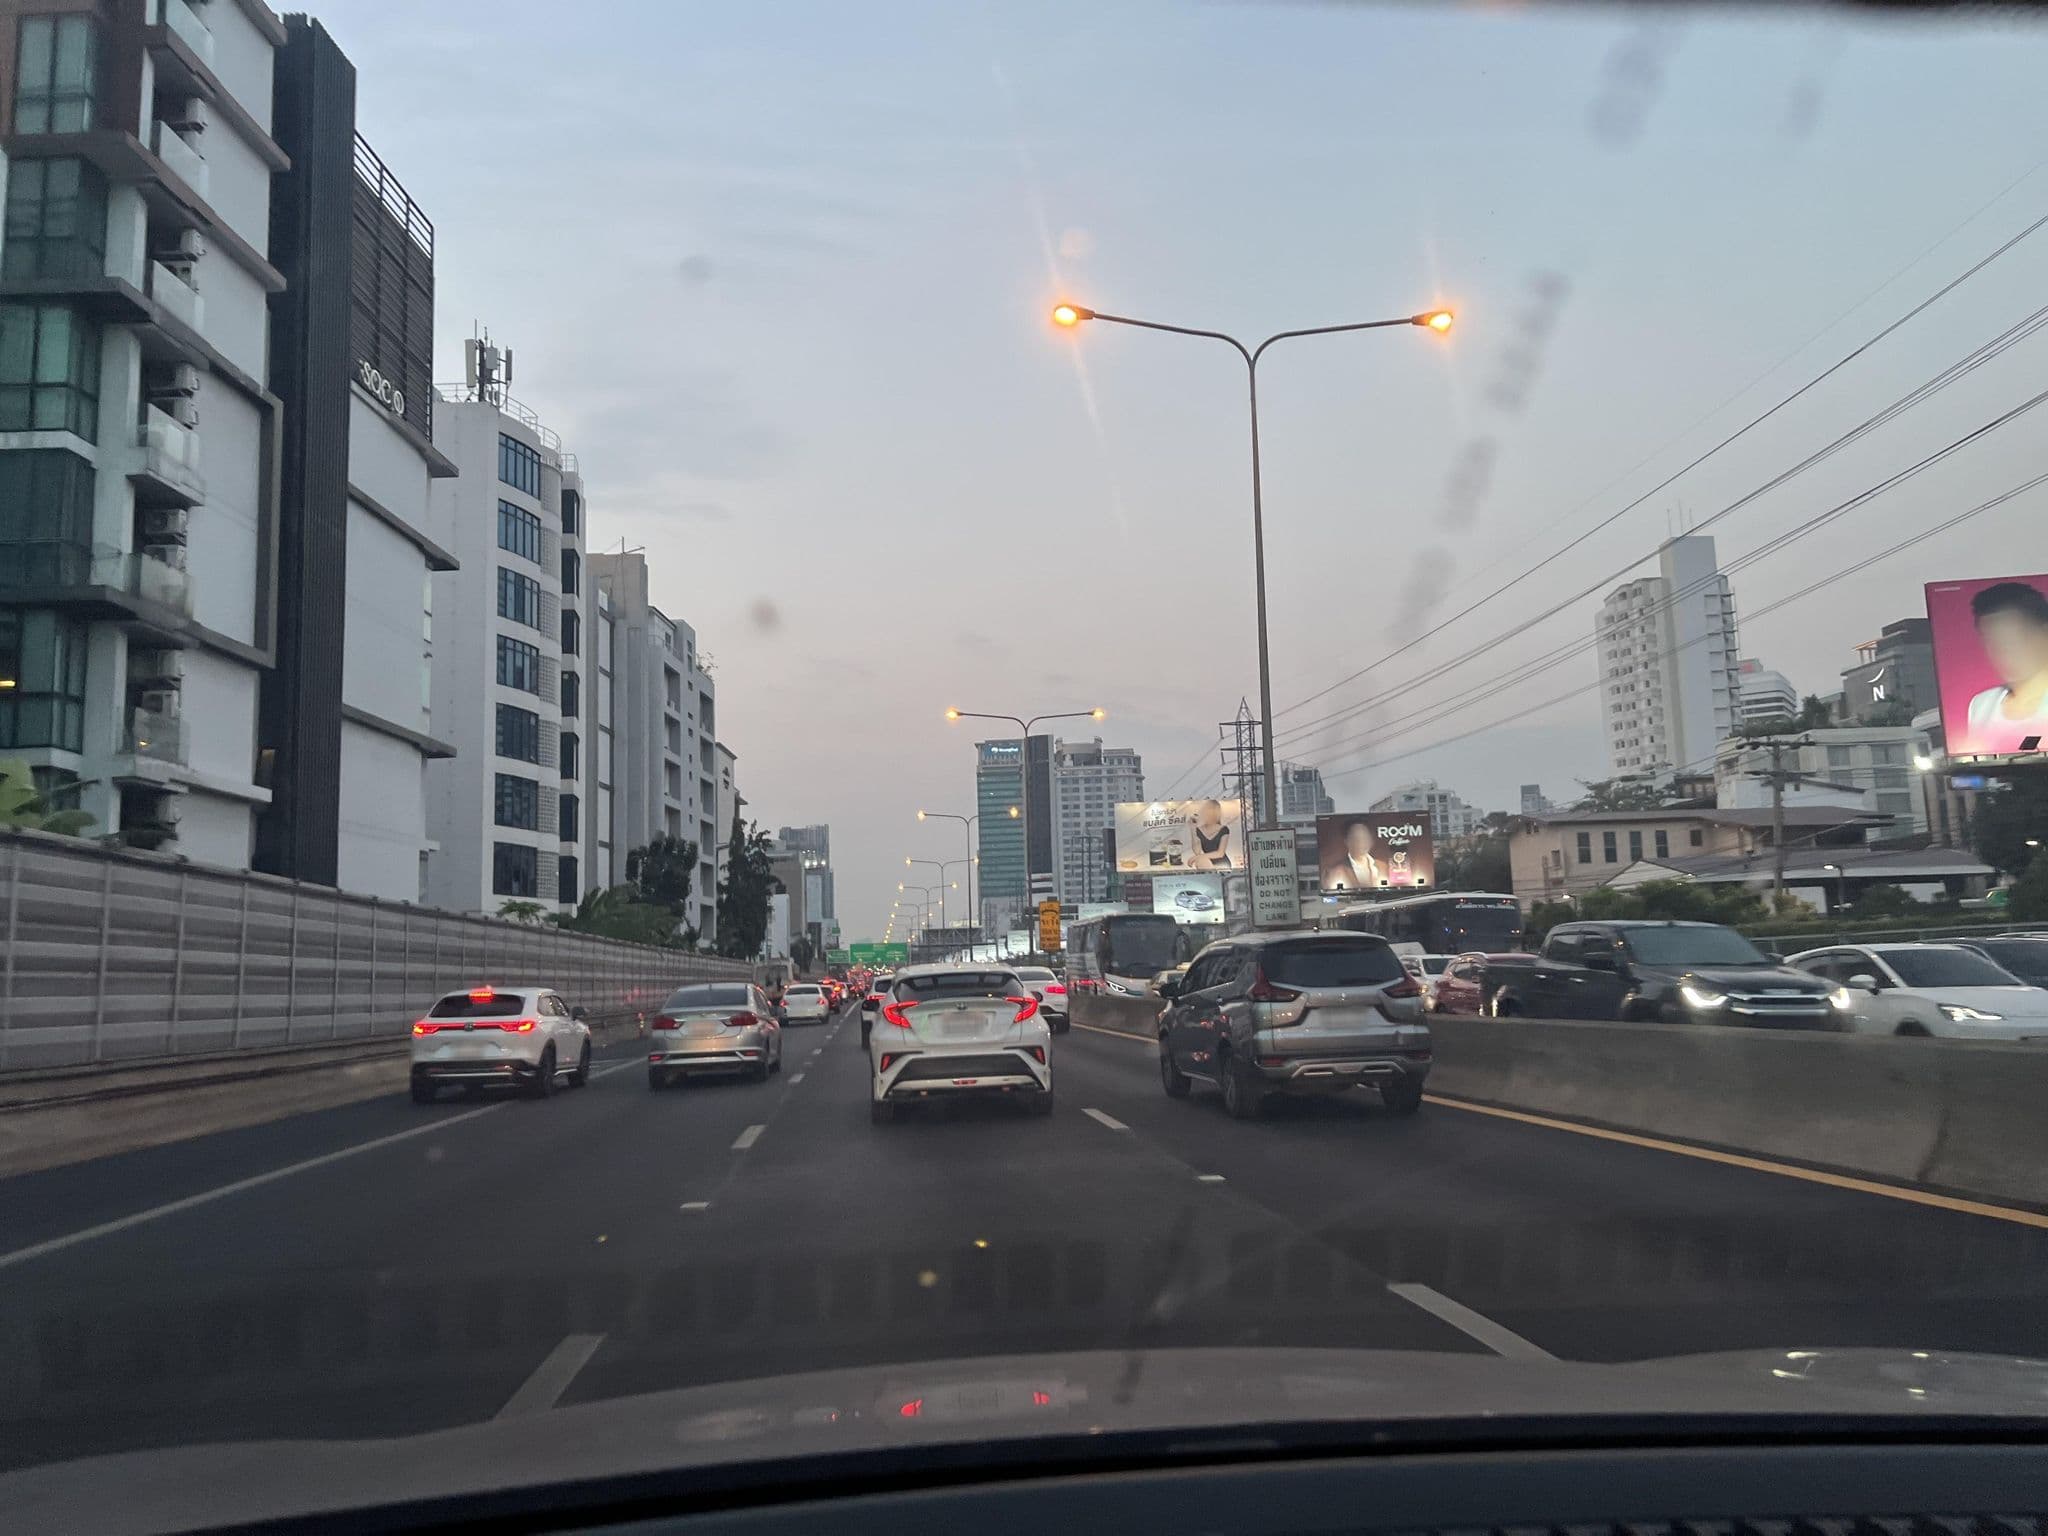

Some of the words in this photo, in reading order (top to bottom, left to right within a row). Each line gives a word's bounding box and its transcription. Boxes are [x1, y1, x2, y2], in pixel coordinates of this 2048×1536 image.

[1873, 684, 1885, 702] N
[1260, 853, 1287, 869] เปลี่ยน
[1254, 871, 1295, 887] ช่องจราจร
[1259, 890, 1271, 898] DO
[1273, 888, 1290, 897] NOT
[1258, 901, 1295, 910] CHANGE
[1265, 912, 1288, 921] LANE
